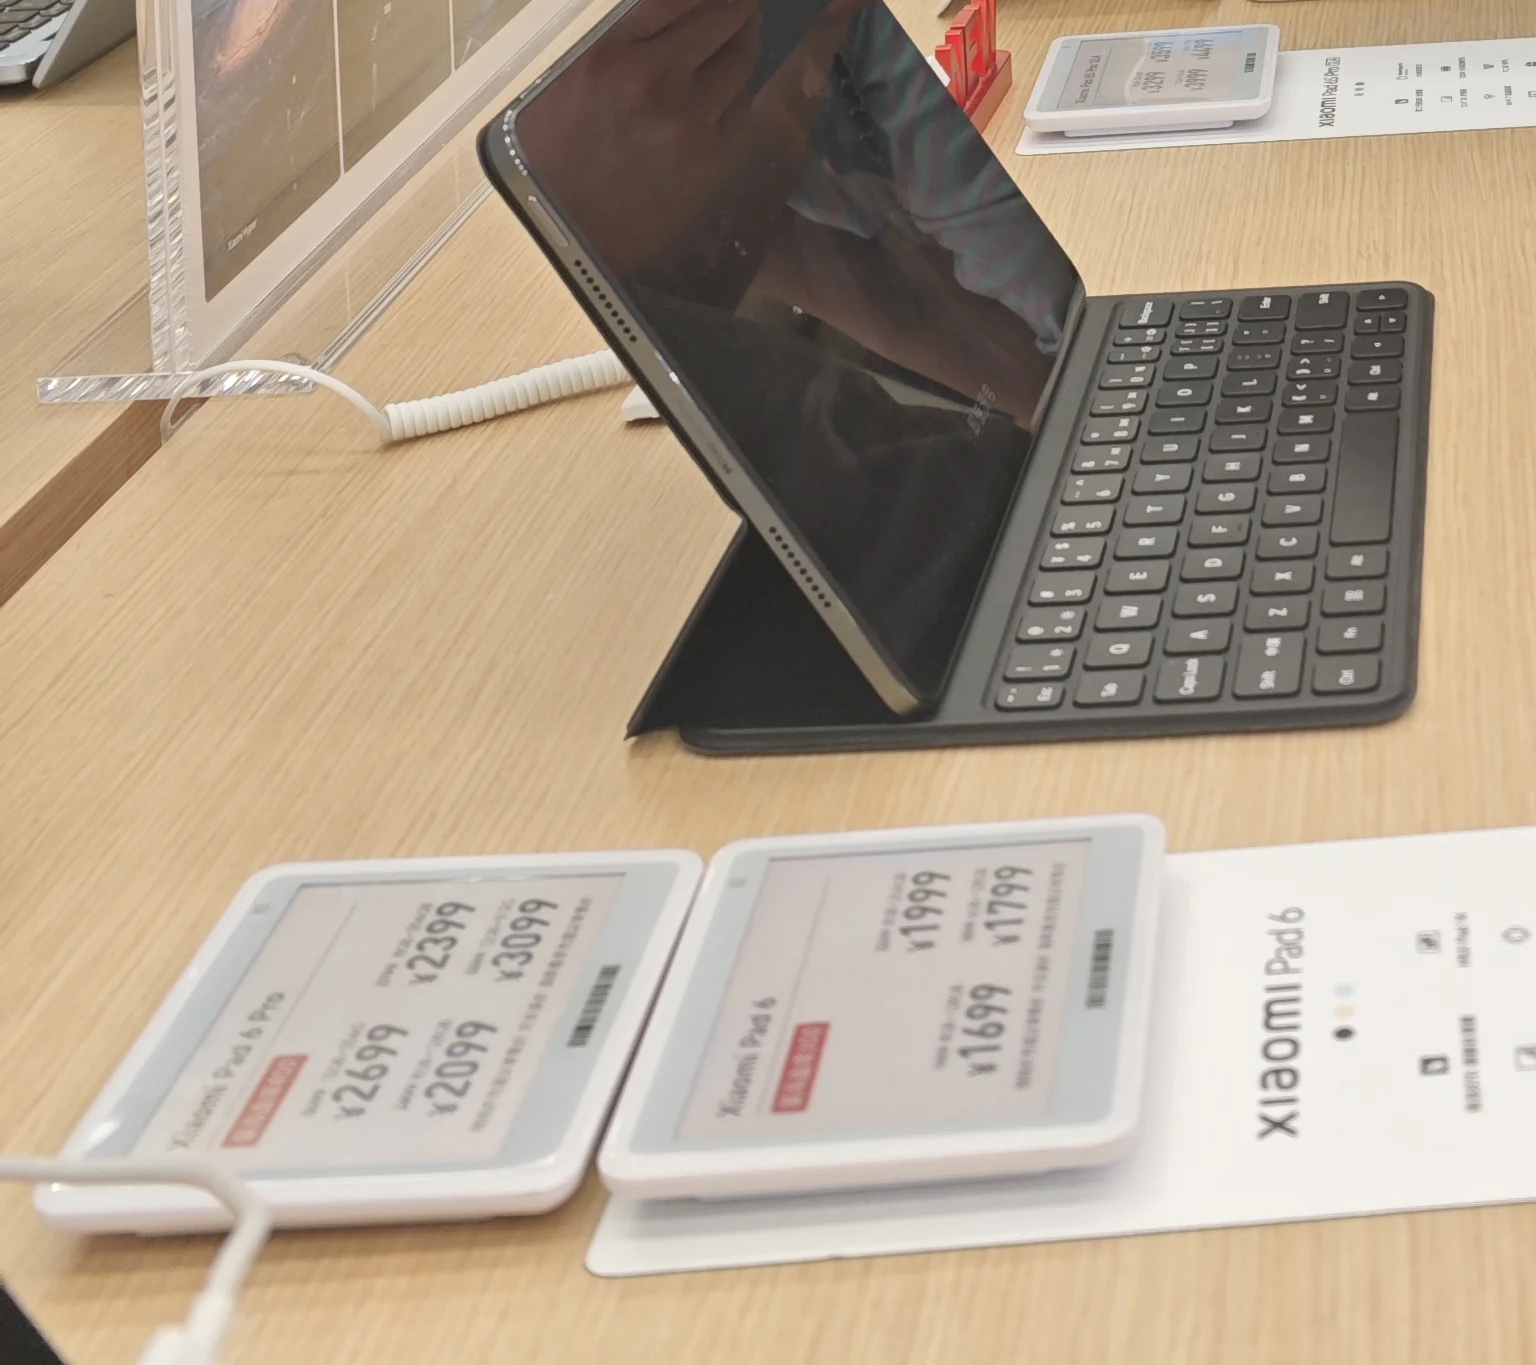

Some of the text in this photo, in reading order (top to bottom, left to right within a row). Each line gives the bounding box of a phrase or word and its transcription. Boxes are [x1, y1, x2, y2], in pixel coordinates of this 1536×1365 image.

[1324, 67, 1340, 77] Pro
[1321, 84, 1338, 97] Pad
[1183, 362, 1199, 371] P
[1241, 378, 1258, 386] L
[1176, 388, 1193, 397] O
[1236, 405, 1252, 413] K
[1298, 414, 1314, 425] M
[1162, 443, 1179, 452] U
[1293, 443, 1310, 453] N
[1224, 461, 1241, 471] H
[1154, 473, 1171, 482] Y
[1288, 473, 1306, 482] B
[1217, 492, 1236, 502] G
[1145, 504, 1163, 514] T
[1284, 504, 1302, 514] V
[1211, 525, 1228, 533] F
[1137, 536, 1156, 546] R
[1279, 536, 1298, 547] C
[1203, 557, 1223, 568] D
[1128, 571, 1148, 580] E
[1274, 571, 1293, 581] X
[1196, 593, 1217, 603] S
[1119, 605, 1139, 618] W
[1267, 607, 1288, 617] Z
[1189, 629, 1209, 640] A
[1108, 643, 1130, 655] Q
[1100, 682, 1118, 698] Tab
[985, 864, 1034, 947] ¥1799
[900, 870, 953, 953] ¥1999
[1267, 905, 1305, 925] 6
[406, 901, 475, 986] ¥2399
[492, 898, 559, 984] ¥3099
[1264, 927, 1304, 976] Pad
[249, 991, 286, 1024] Pro
[240, 1027, 263, 1041] 6
[958, 983, 1013, 1077] ¥1699
[213, 1044, 244, 1080] Pad
[717, 996, 779, 1118] Xiaomi Pad 6
[331, 1023, 409, 1122] ¥2699
[425, 1020, 499, 1118] ¥2099
